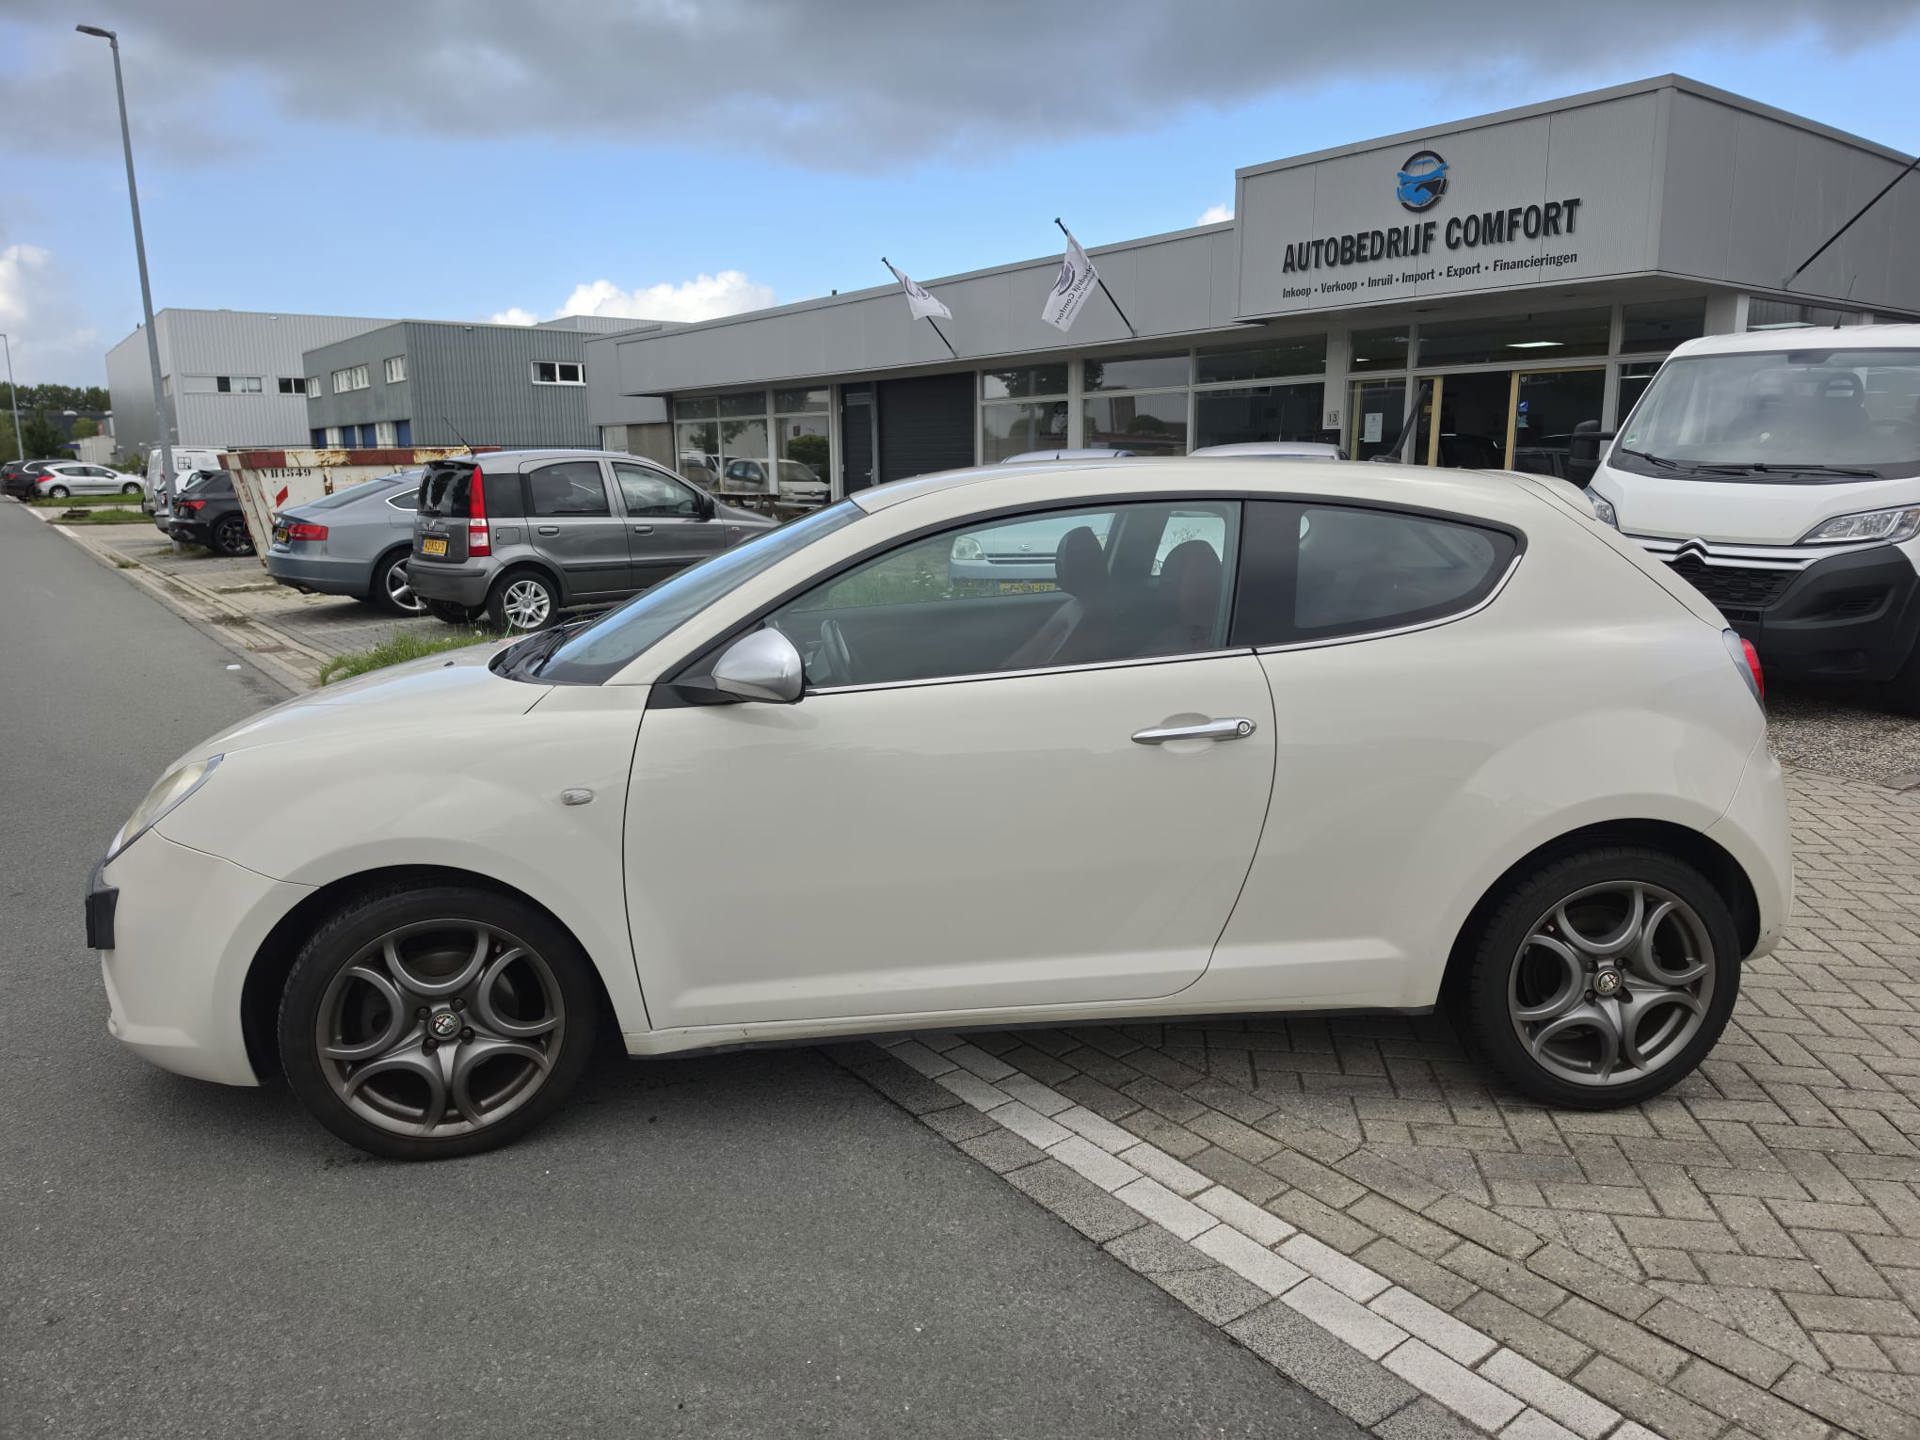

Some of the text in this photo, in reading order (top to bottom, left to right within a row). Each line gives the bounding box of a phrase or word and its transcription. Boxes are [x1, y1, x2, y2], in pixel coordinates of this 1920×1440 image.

[1282, 198, 1581, 273] AUTOBEDRIJF COMFORT
[1282, 253, 1577, 298] Inkoop Verkoop Inruil Import Export Financieringen
[1328, 413, 1338, 423] 13
